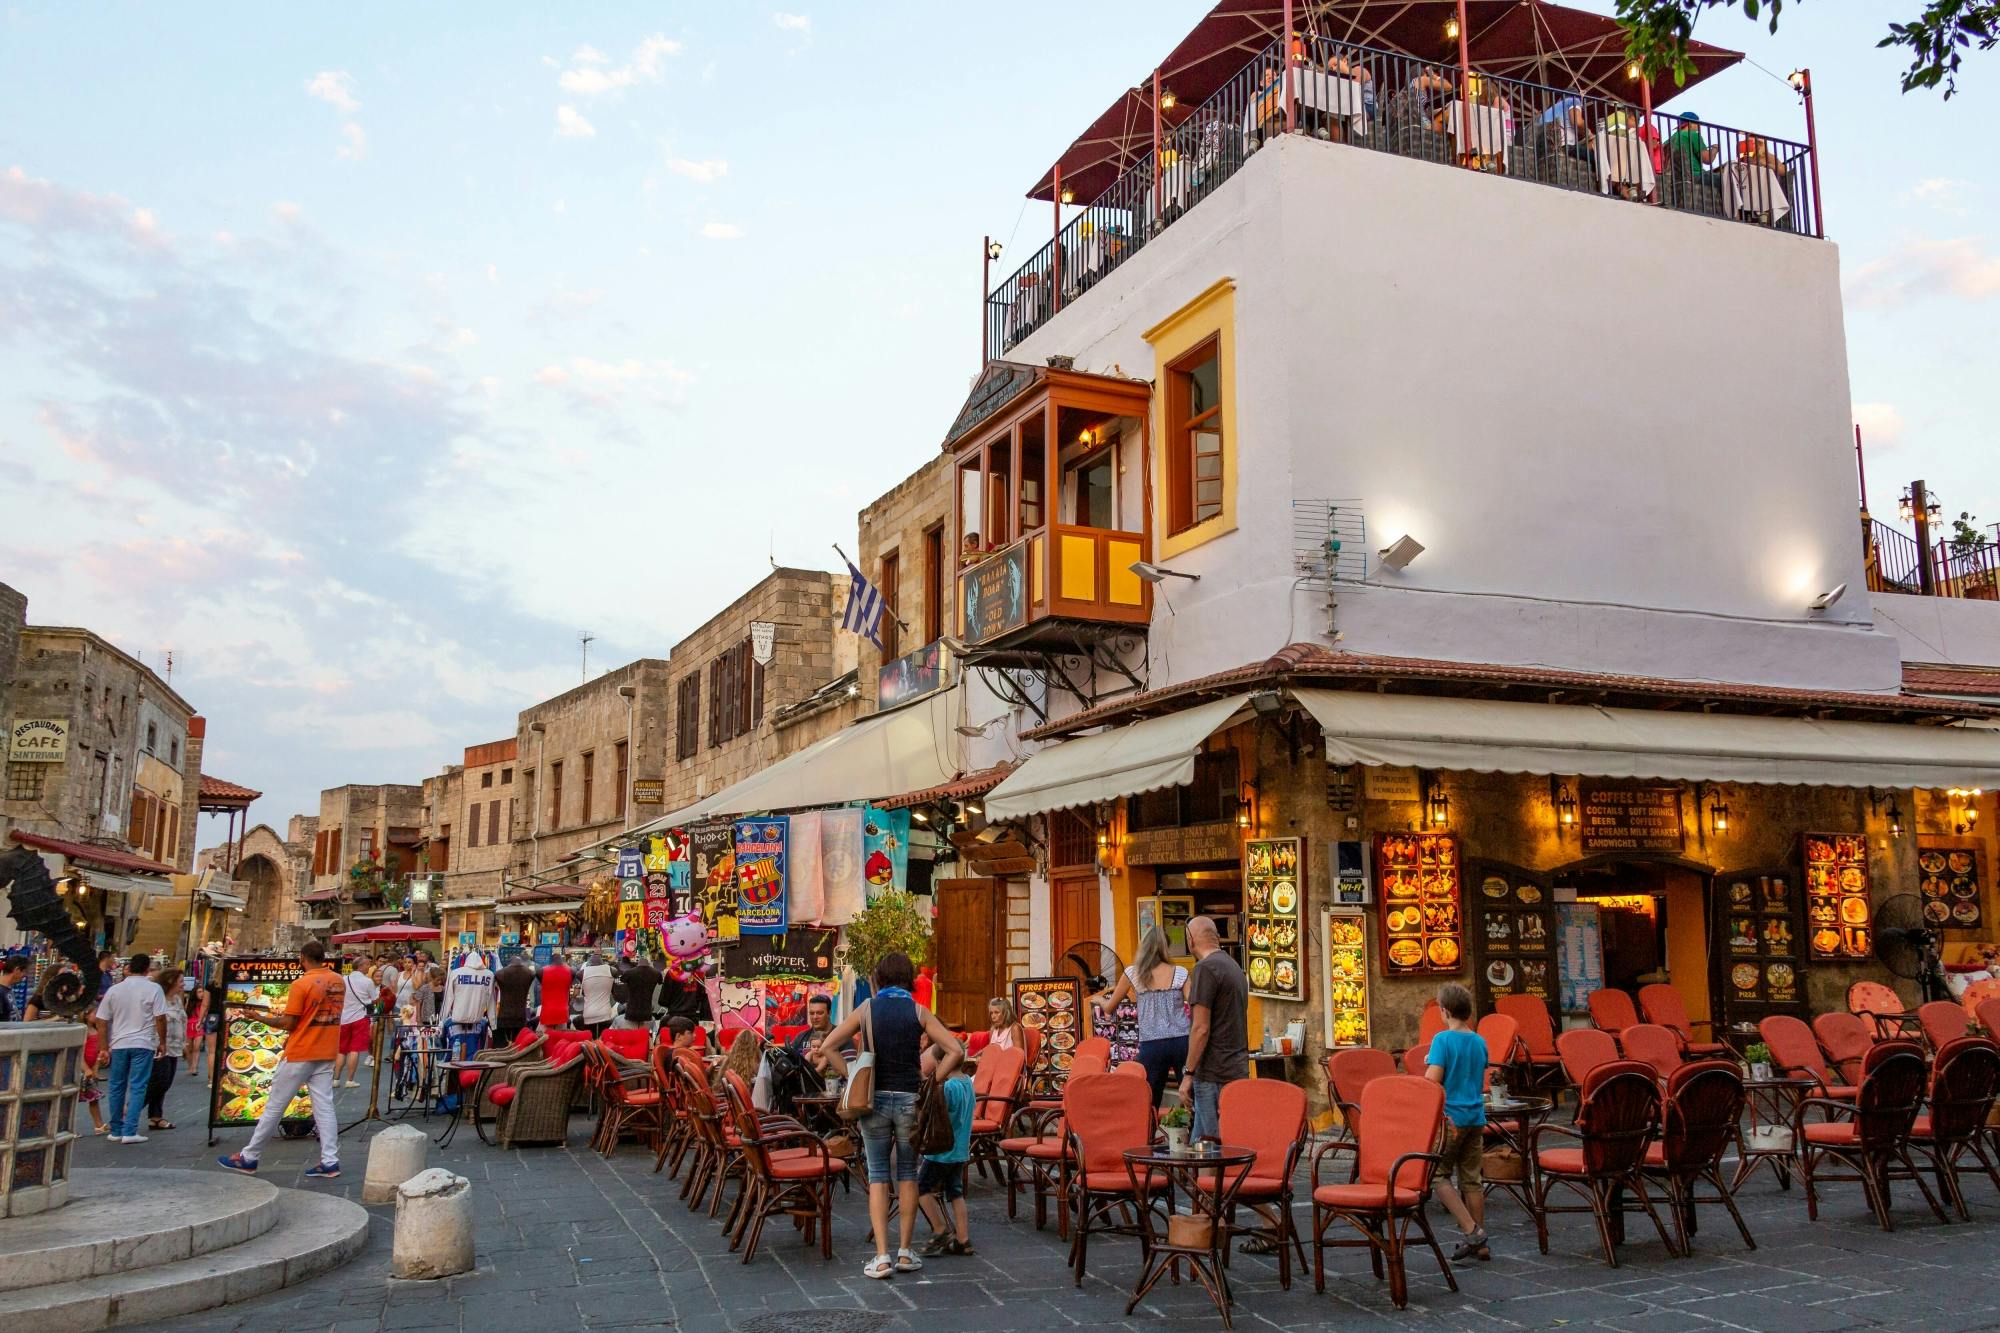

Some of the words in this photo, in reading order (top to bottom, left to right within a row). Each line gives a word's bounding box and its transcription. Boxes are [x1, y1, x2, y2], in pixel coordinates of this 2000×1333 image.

[15, 720, 65, 737] RESTAURANT
[17, 737, 61, 748] CAFE
[12, 751, 63, 760] SINTRIVANI
[1591, 791, 1633, 803] COFFEE
[1637, 792, 1659, 804] BAR
[1586, 806, 1624, 815] COCTAILS
[1629, 807, 1647, 816] SOFT
[1648, 808, 1675, 816] DRINKS
[1592, 816, 1616, 825] BEERS
[694, 831, 728, 844] RHODES
[1584, 827, 1596, 835] ICE
[1598, 827, 1629, 836] CREAMS
[1630, 828, 1648, 836] MILK
[1650, 828, 1680, 836] SHAKES
[1184, 838, 1215, 849] NICOLAS
[1588, 839, 1637, 847] SANDWICHES
[1644, 840, 1673, 848] SNACKS
[648, 854, 667, 870] 24
[1127, 854, 1144, 865] CAFE
[1185, 848, 1210, 861] SNACK
[1212, 847, 1229, 859] BAR
[623, 863, 638, 877] 13
[625, 885, 639, 900] 34
[650, 883, 667, 898] 23
[1340, 883, 1362, 891] WI-FI
[649, 911, 664, 925] 23
[738, 908, 781, 917] BARCELONA
[625, 912, 640, 928] 23
[230, 962, 286, 970] CAPTAINS
[457, 974, 492, 987] HELLAS
[1044, 982, 1074, 990] SPECIAL
